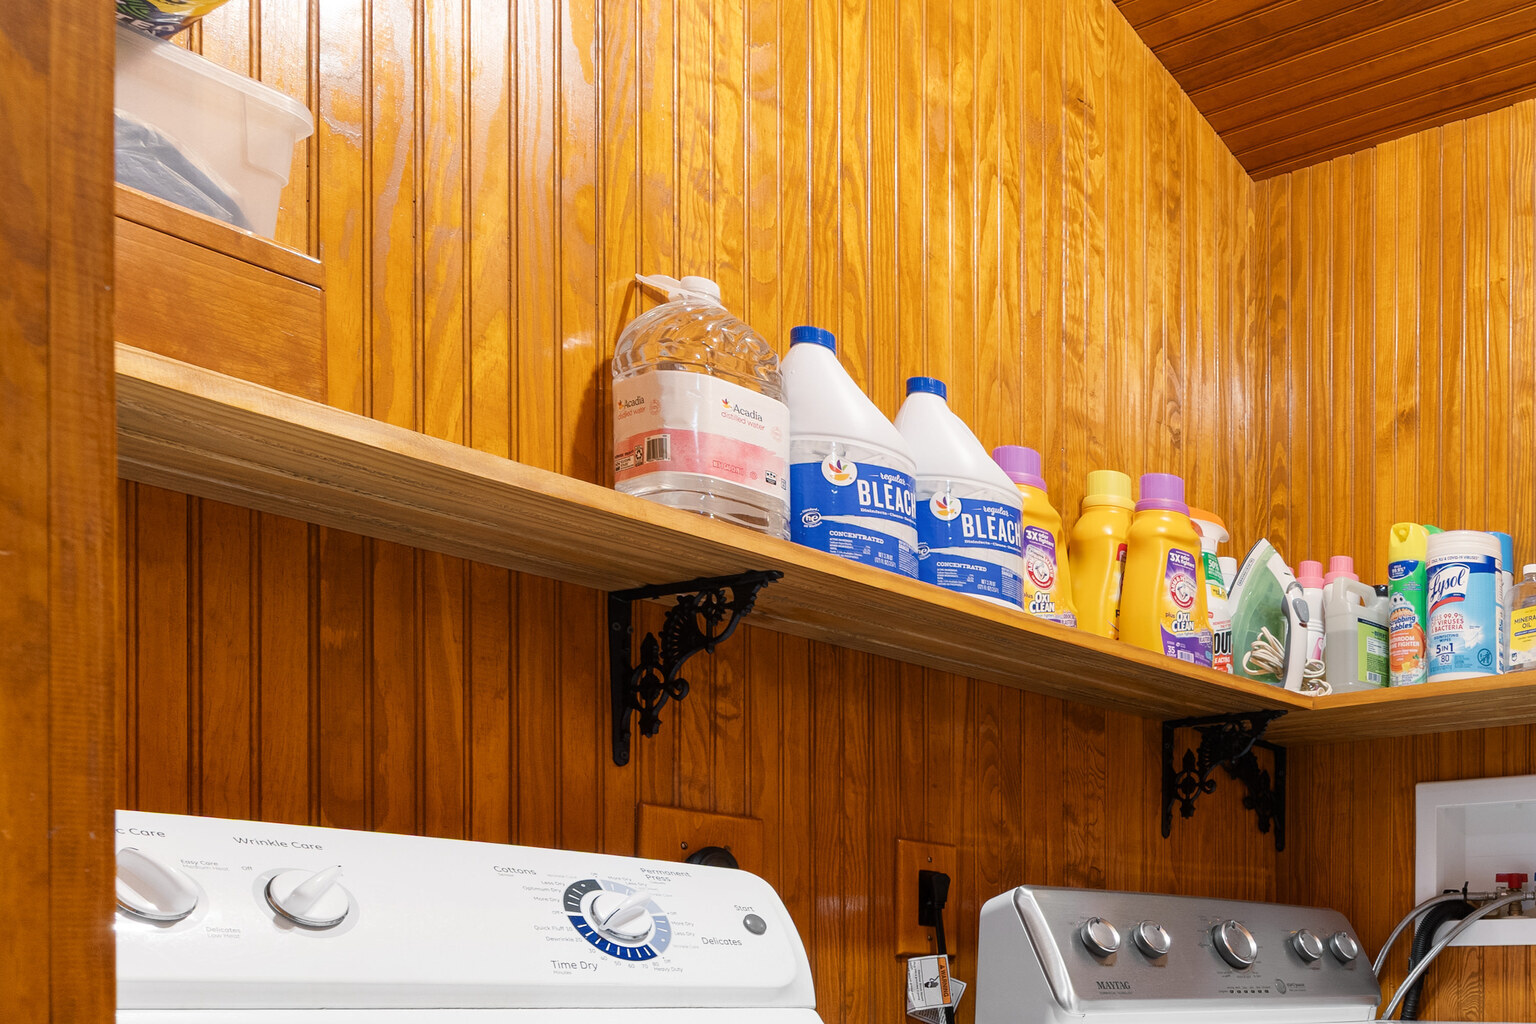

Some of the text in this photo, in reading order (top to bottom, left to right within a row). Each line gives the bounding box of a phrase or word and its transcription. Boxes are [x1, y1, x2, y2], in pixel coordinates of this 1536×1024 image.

[624, 396, 645, 408] Acadia
[733, 404, 763, 422] Acadia
[721, 411, 765, 430] distilled water
[880, 472, 906, 485] regular
[857, 479, 917, 519] BLEACH
[982, 506, 1010, 517] regular
[961, 513, 1021, 547] BLEACH
[1025, 530, 1038, 541] 3X
[829, 530, 885, 544] CONCENTRATED
[1169, 553, 1181, 564] 3X
[936, 562, 987, 572] CONCENTRATED
[1430, 568, 1466, 602] Lysol
[1035, 591, 1050, 602] OXI
[1029, 600, 1055, 613] CLEAN
[1176, 611, 1191, 622] OXI
[1171, 620, 1195, 632] CLEAN
[1435, 624, 1464, 632] BACTERIA
[1437, 619, 1464, 627] VIRUSES
[1167, 645, 1176, 654] 35
[1436, 644, 1441, 654] 5
[1449, 643, 1454, 652] 1
[1440, 655, 1450, 663] 80
[128, 827, 166, 838] Care
[232, 836, 323, 851] Wrinkle Care
[493, 865, 537, 875] Cottons
[640, 867, 692, 877] Permanent
[645, 874, 671, 882] Press
[734, 904, 754, 912] Start
[701, 937, 743, 946] Delicates
[550, 960, 598, 971] Time Dry
[941, 969, 949, 998] WARNING
[1096, 981, 1131, 990] MAYTAG
